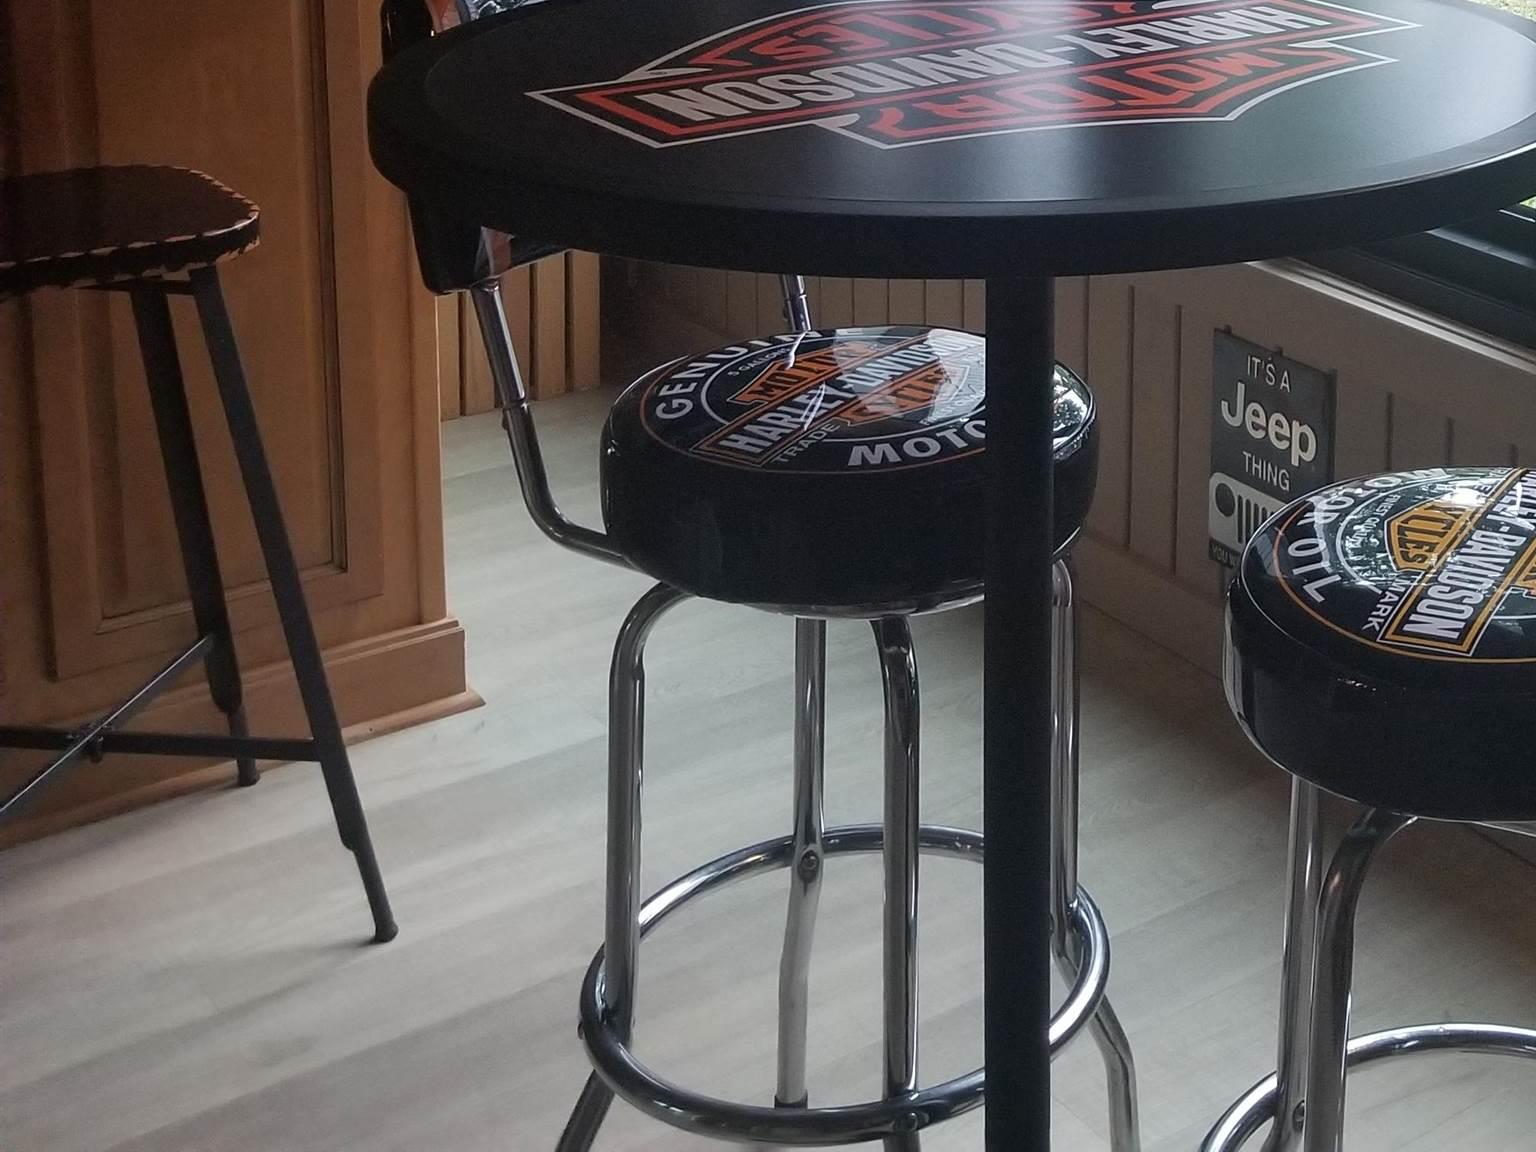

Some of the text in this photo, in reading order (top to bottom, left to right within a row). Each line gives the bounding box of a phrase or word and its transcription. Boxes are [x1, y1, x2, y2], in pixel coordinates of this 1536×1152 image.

[749, 3, 1101, 61] CYCLES
[633, 6, 1332, 122] HARLEY-DAVIDSON
[912, 51, 1286, 119] MOTOR
[1247, 355, 1292, 393] IT'S A
[771, 423, 840, 464] TRADE
[848, 419, 986, 466] MOTO
[1221, 380, 1318, 467] Jeep
[1242, 450, 1290, 492] THING
[1287, 538, 1342, 603] OIL
[1362, 578, 1406, 631] MARK
